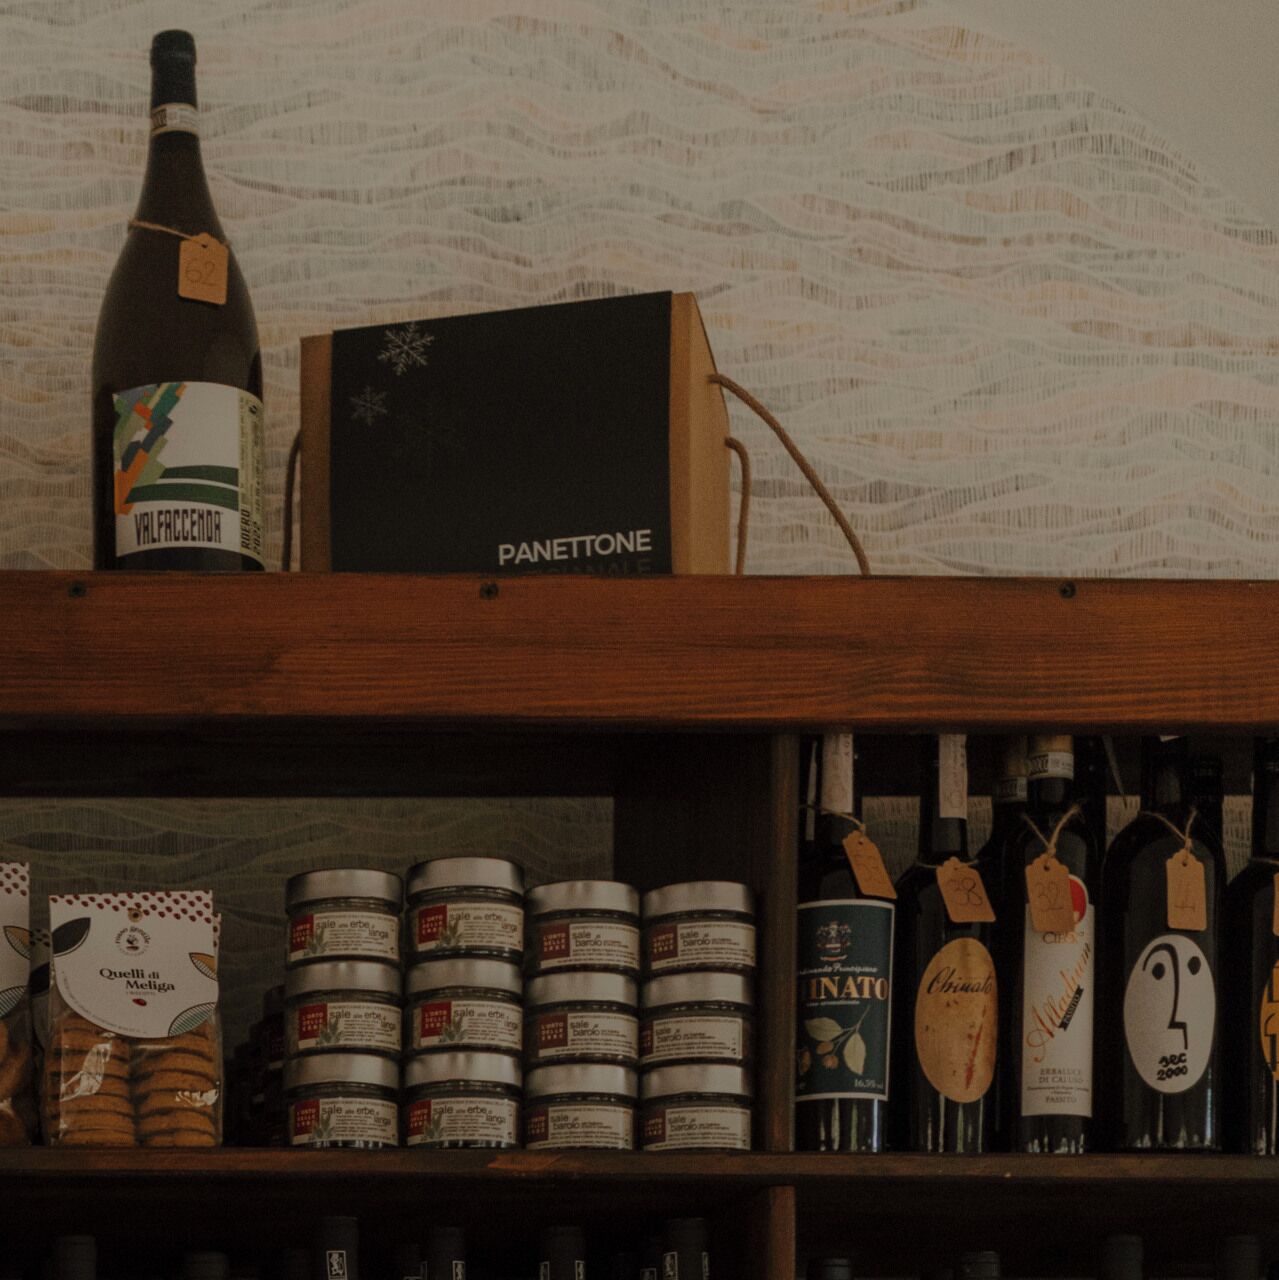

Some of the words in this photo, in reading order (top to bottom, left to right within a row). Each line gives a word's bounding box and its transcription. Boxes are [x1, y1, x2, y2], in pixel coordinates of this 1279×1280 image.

[135, 508, 222, 546] VALFACCENDA
[498, 529, 652, 566] PANETTONE
[315, 918, 337, 929] sale
[350, 918, 371, 929] erbe
[99, 967, 145, 981] Quelli
[147, 968, 160, 980] di
[926, 965, 993, 995] Chinato
[125, 979, 176, 993] Meliga
